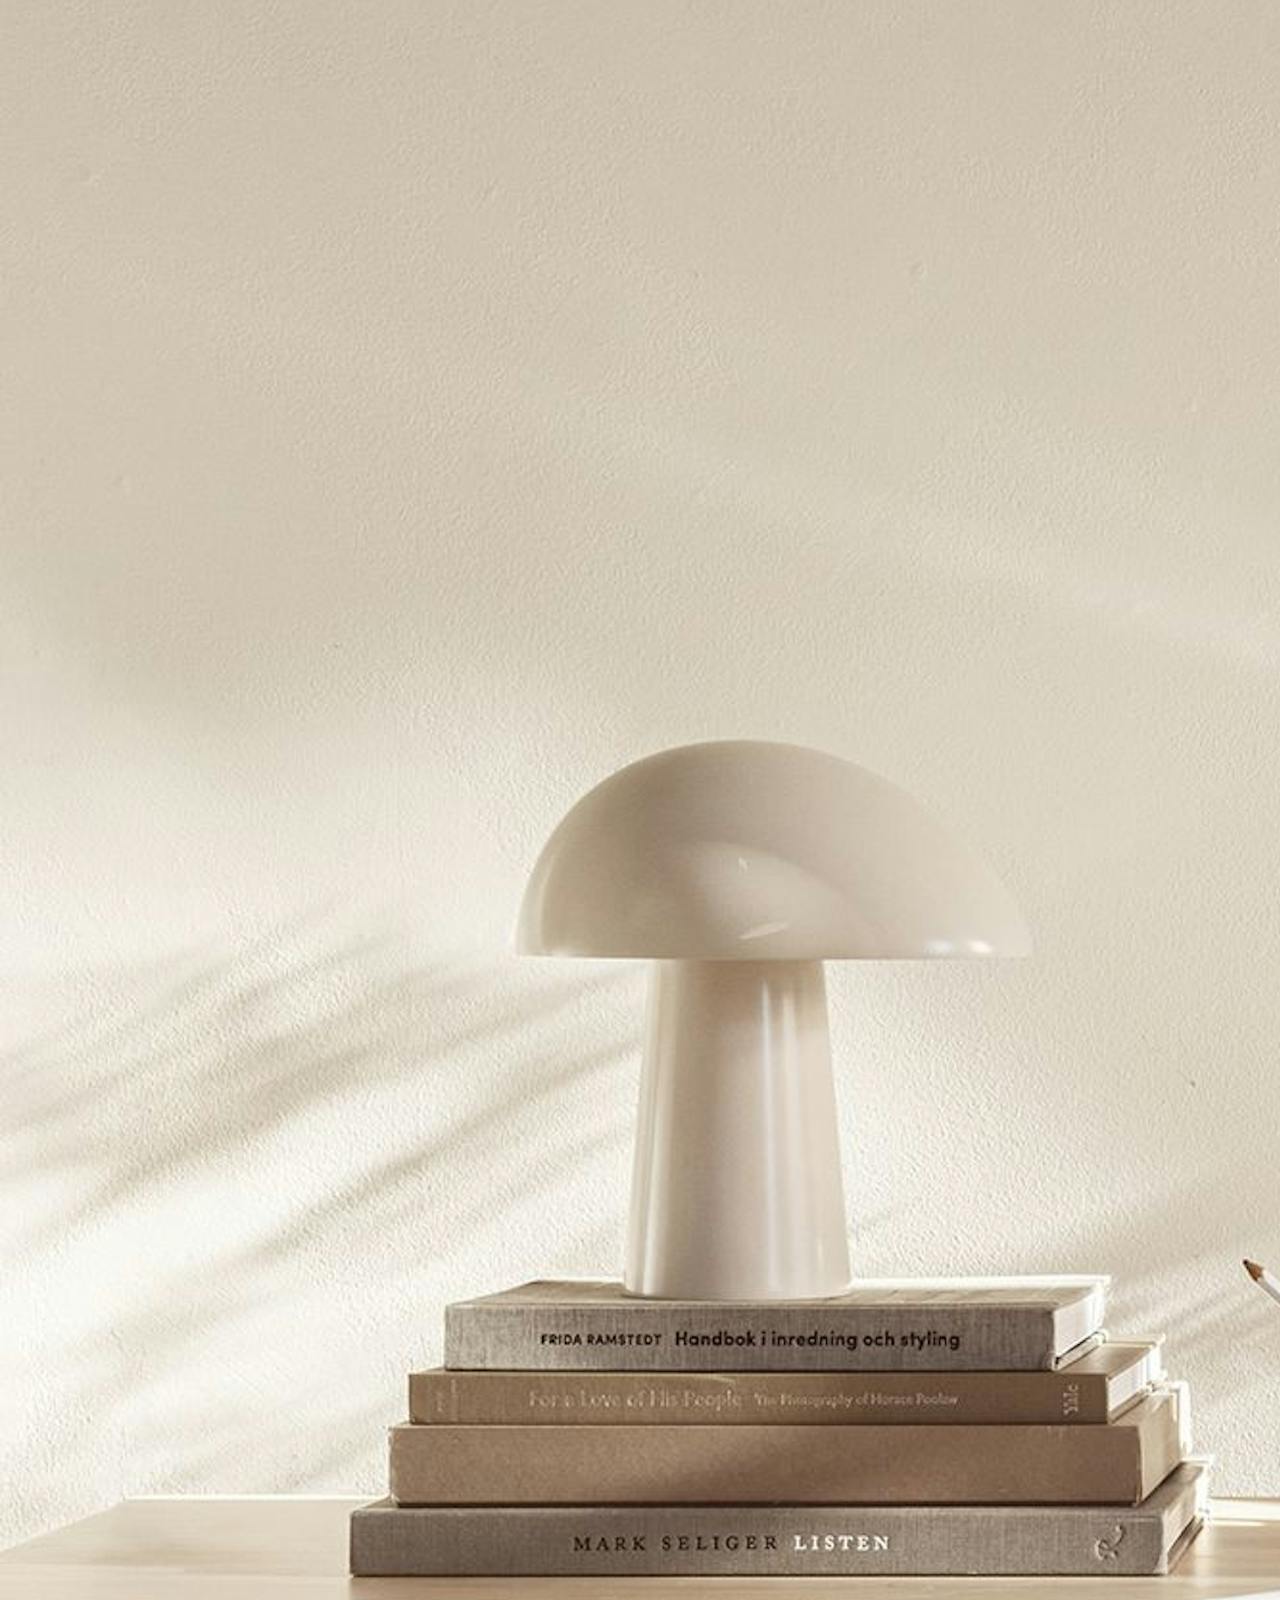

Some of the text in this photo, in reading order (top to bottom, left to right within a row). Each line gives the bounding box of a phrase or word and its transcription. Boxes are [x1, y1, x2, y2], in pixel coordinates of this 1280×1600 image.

[541, 1330, 961, 1350] FRIDA RAMSTEDT Handbok i inredning och styling
[529, 1390, 556, 1408] For
[685, 1389, 742, 1412] People
[573, 1534, 890, 1551] MARK SELIGER LISTEN
